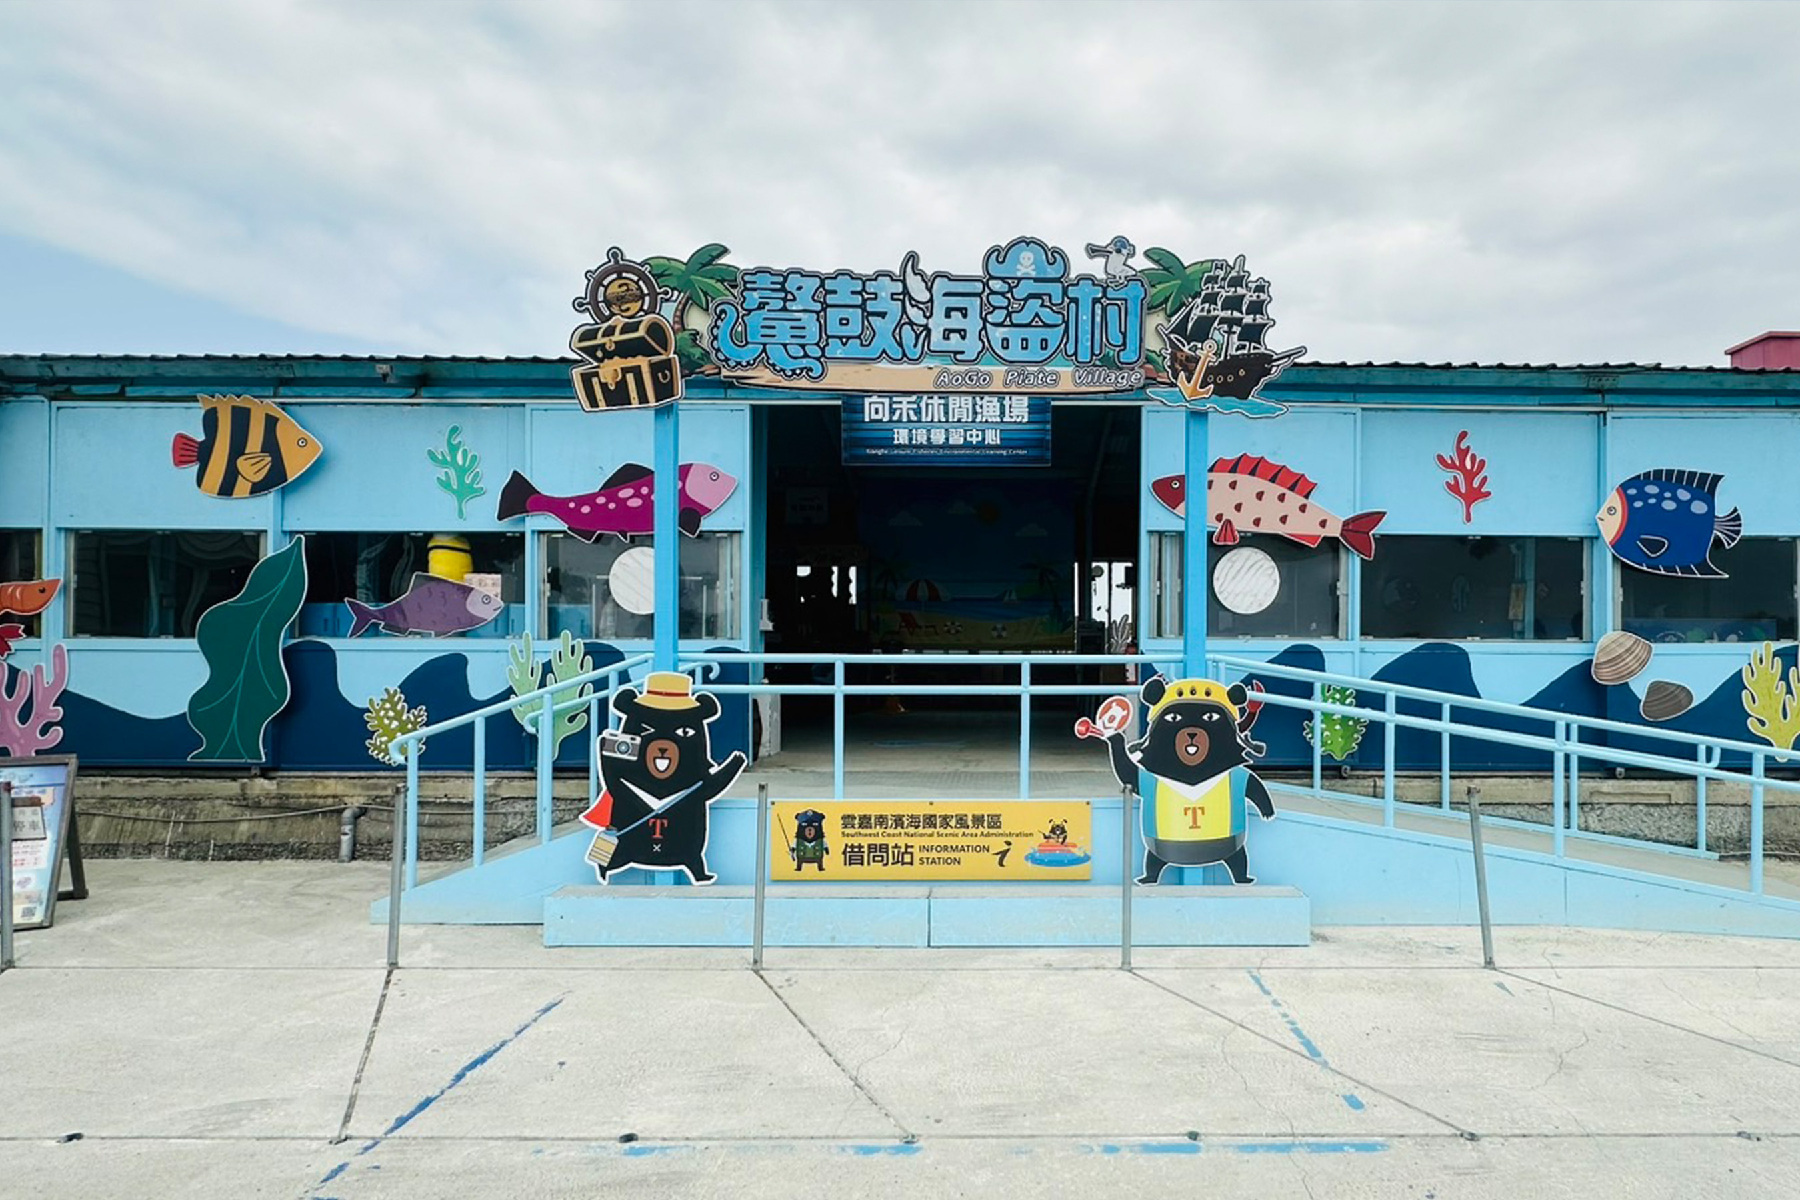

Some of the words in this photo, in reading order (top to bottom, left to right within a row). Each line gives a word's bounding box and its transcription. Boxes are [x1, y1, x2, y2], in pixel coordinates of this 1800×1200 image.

[935, 370, 992, 389] AoGo
[1004, 370, 1058, 388] Piate
[1074, 370, 1143, 388] Village
[892, 428, 1001, 445] 環境學習中心
[840, 813, 1002, 830] 雲嘉南濱海國家風景區
[1183, 806, 1206, 829] T
[648, 818, 668, 839] T
[842, 843, 914, 867] 借問站
[918, 844, 990, 854] INFORMATION
[918, 857, 961, 866] STATION
